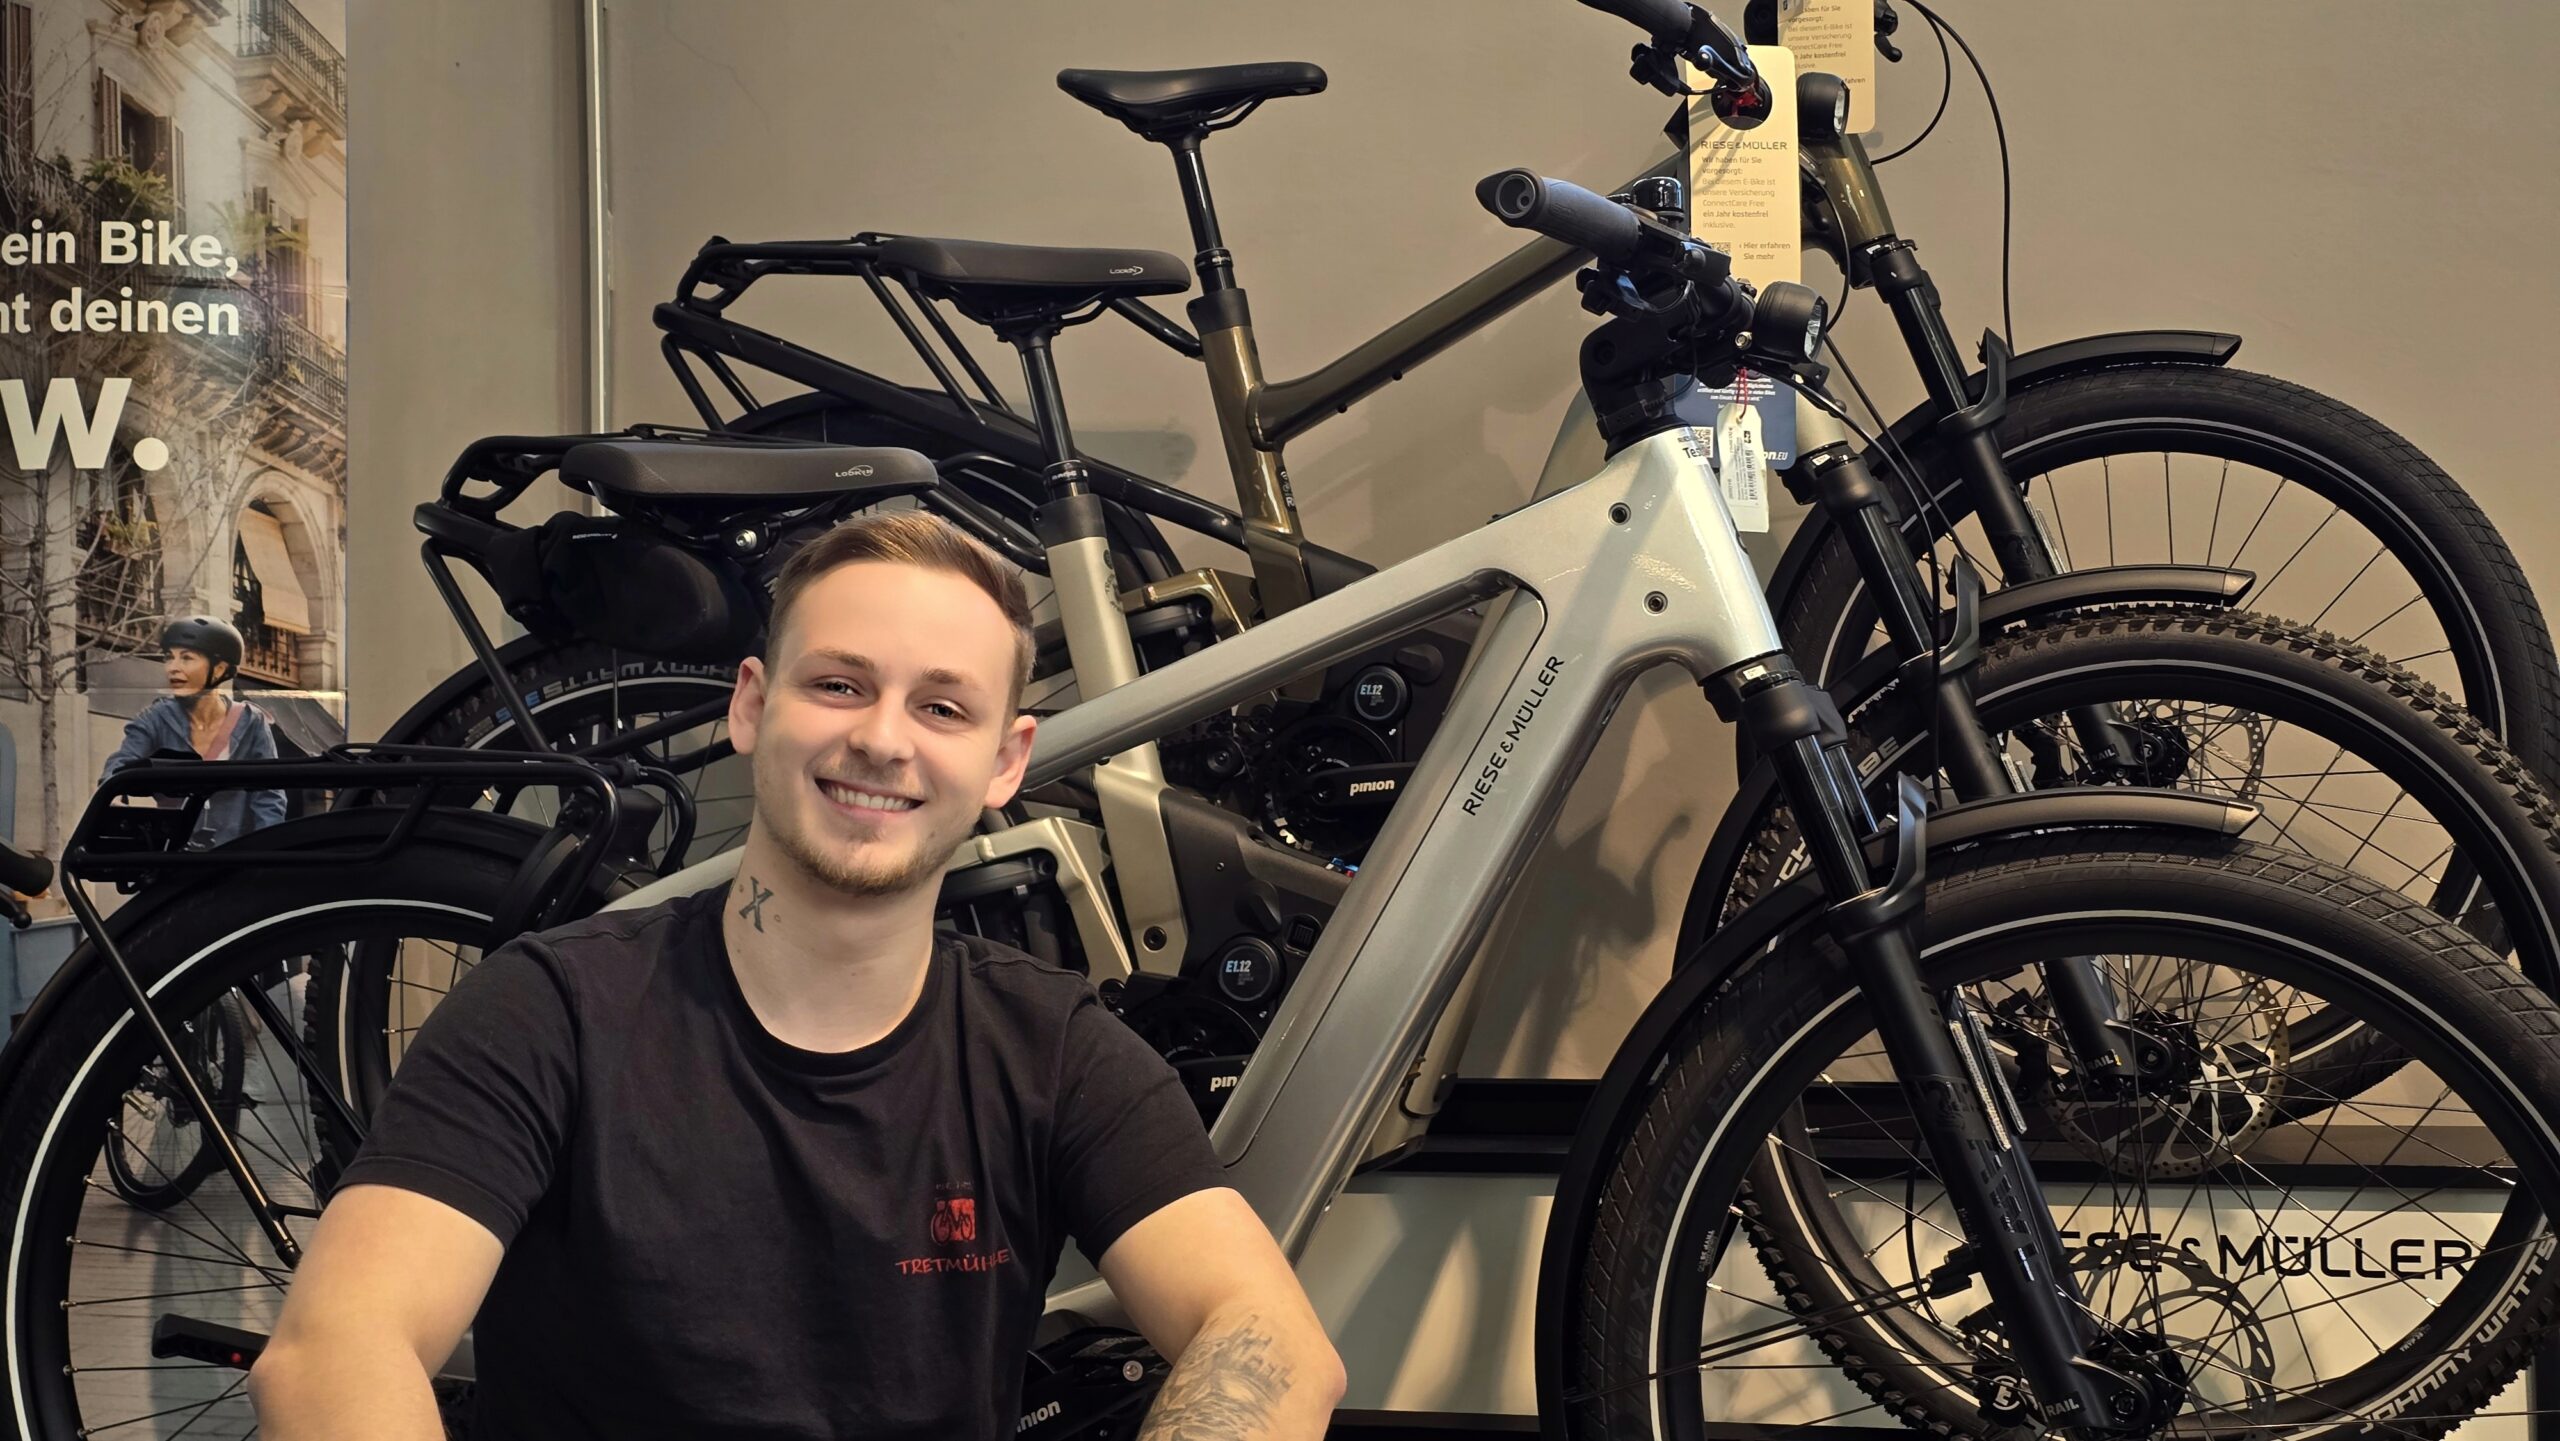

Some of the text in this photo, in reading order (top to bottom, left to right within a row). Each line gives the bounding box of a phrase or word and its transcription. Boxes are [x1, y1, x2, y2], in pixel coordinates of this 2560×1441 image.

[1700, 141, 1734, 150] RIESE
[1743, 140, 1788, 150] MÜLLER
[101, 219, 239, 278] Bike,
[1760, 241, 1791, 249] erfahren
[50, 286, 240, 336] deinen
[1360, 684, 1383, 695] E1.12
[1462, 656, 1565, 816] RIESE & MÜLLER
[1349, 780, 1395, 797] pinion
[1226, 960, 1251, 973] E1.12
[1210, 1076, 1239, 1092] pin
[2220, 1234, 2474, 1281] MÜLLER
[2359, 1236, 2558, 1435] JOHNNY WATTS
[2045, 1398, 2080, 1417] RAIL
